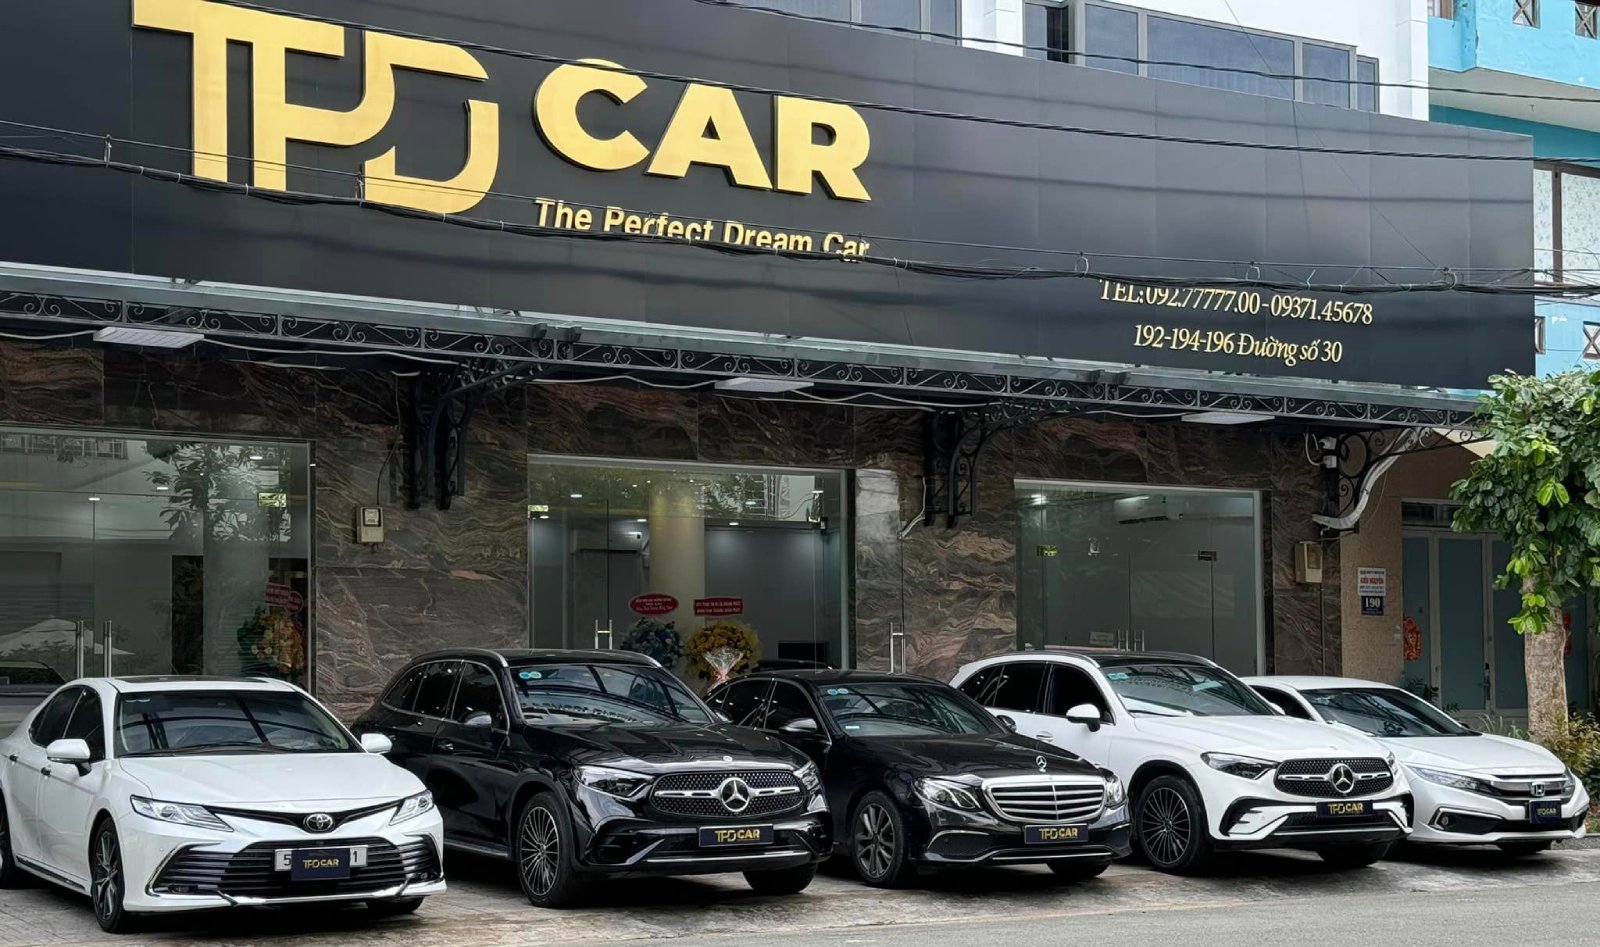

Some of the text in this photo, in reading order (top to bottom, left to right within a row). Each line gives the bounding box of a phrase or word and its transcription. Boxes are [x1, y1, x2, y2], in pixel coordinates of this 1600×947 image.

[533, 59, 872, 202] CAR
[534, 196, 871, 263] The Perfect Dream Car
[1133, 323, 1343, 367] 192-194-196 Đường số 30
[1345, 802, 1363, 812] CAR
[736, 828, 760, 839] CAR
[1058, 827, 1078, 838] CAR
[283, 850, 358, 866] 5 1
[320, 858, 340, 867] CAR
